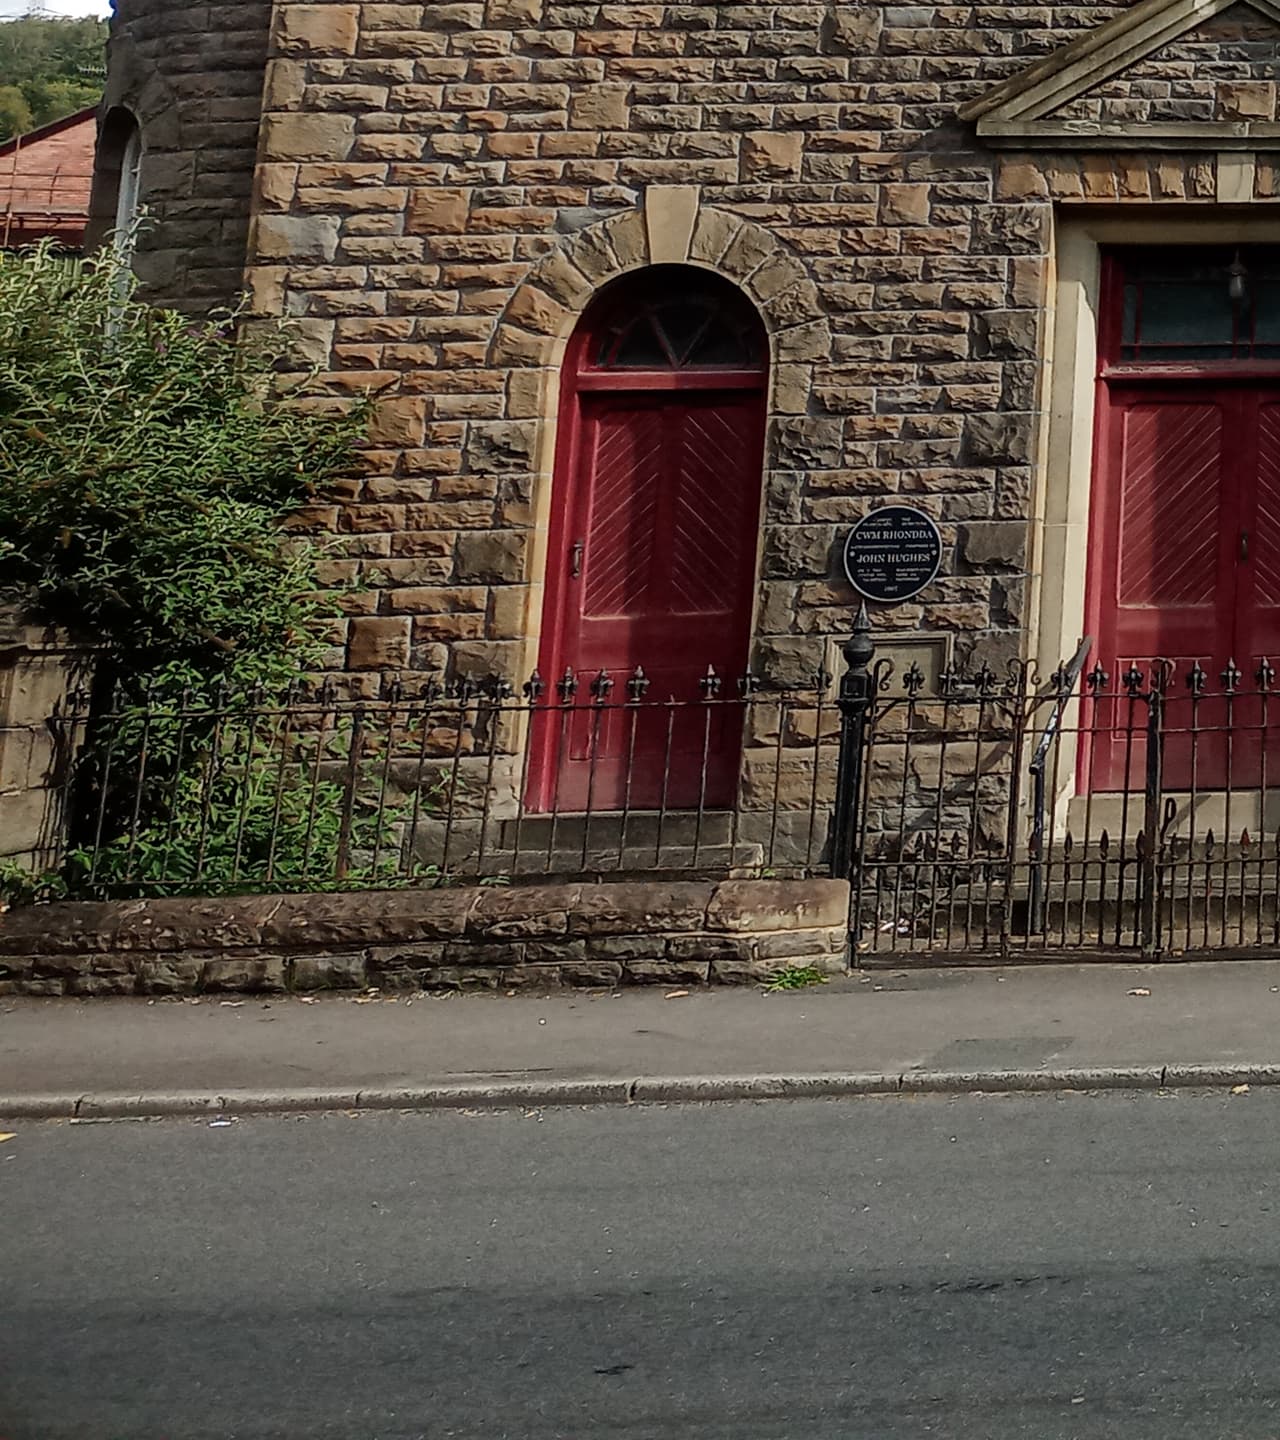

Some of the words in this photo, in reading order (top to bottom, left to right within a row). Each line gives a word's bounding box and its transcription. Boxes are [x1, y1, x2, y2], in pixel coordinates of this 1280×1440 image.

[855, 530, 881, 540] CWM
[882, 530, 933, 540] RHONDDA
[857, 553, 885, 563] JOHN
[887, 553, 931, 563] HUGHES
